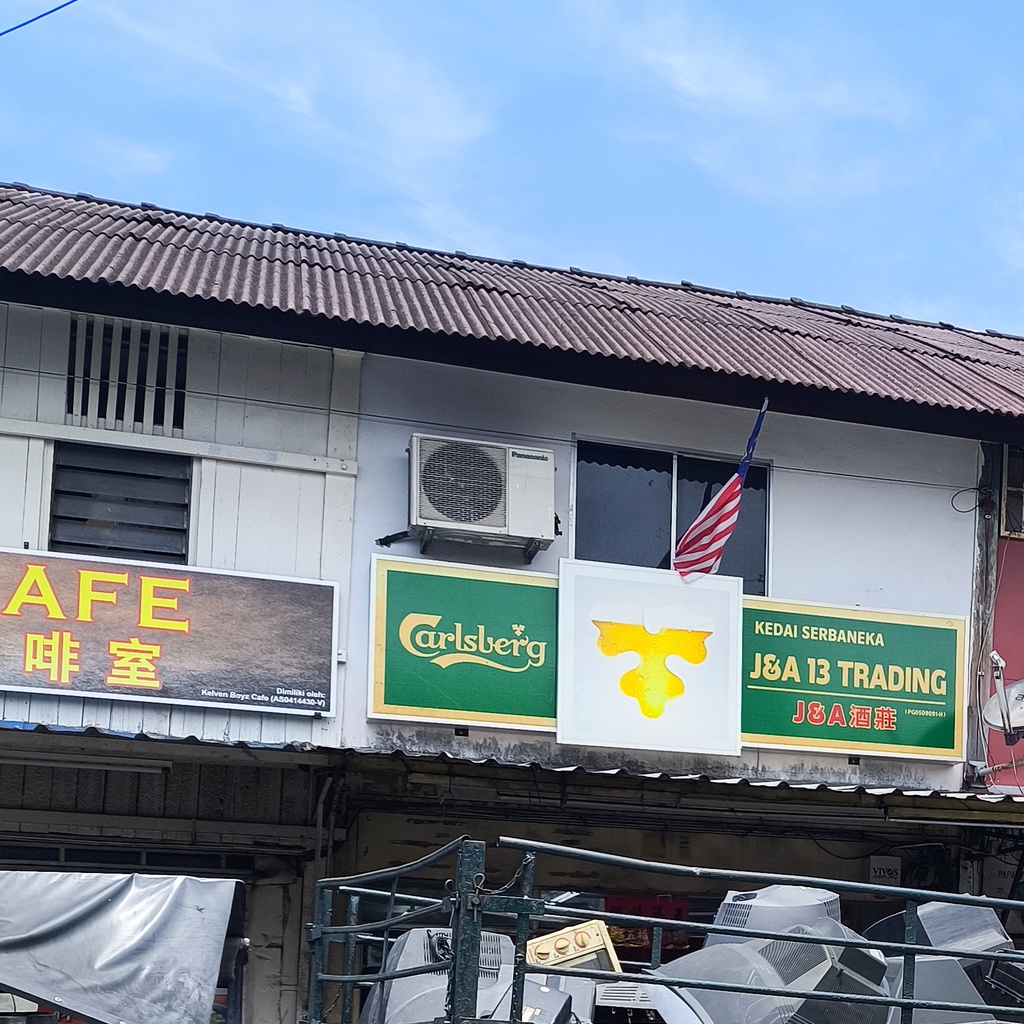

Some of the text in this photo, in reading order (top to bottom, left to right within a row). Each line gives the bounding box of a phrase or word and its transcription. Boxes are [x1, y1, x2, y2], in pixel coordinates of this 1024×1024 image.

[511, 451, 549, 461] Panasonic
[399, 612, 548, 668] Carlsberg
[754, 621, 885, 647] KEDAI SERBANEKA
[750, 652, 947, 696] J&A 13 TRADING
[251, 693, 269, 702] Cafe
[873, 867, 899, 876] VIVOS
